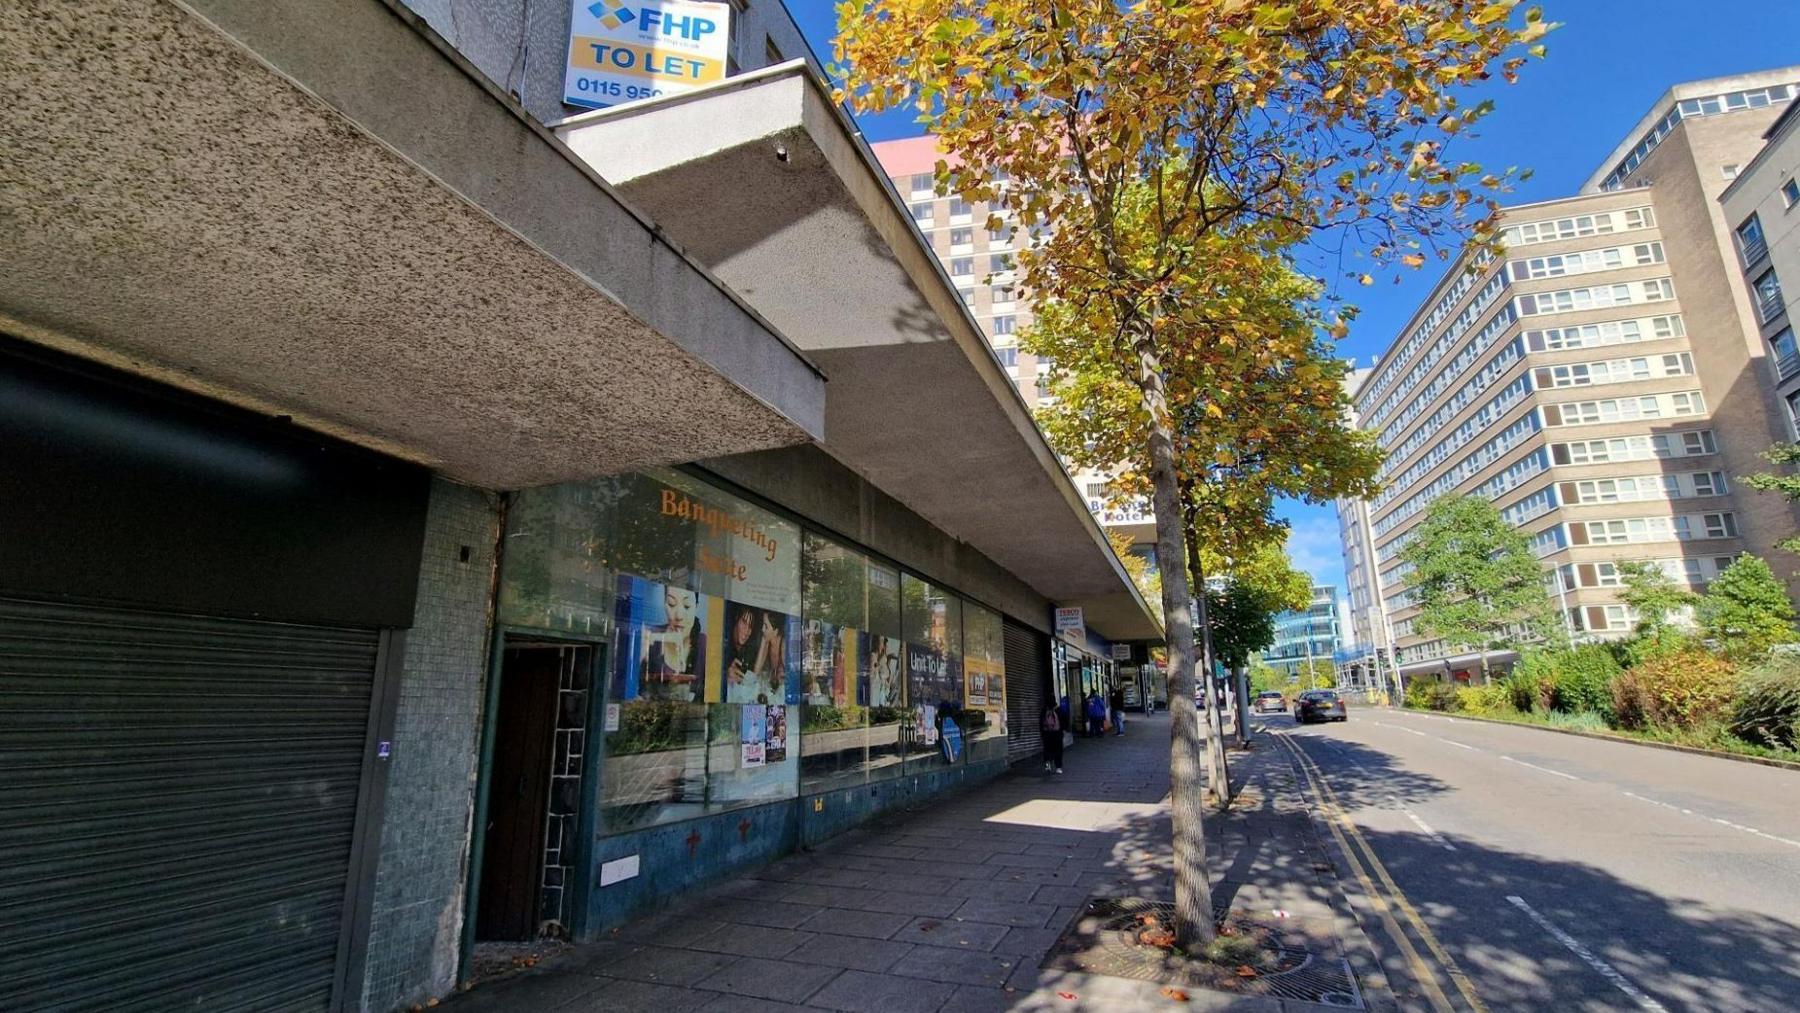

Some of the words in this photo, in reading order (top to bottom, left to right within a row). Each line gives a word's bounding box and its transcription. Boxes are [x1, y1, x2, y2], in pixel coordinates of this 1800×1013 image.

[639, 8, 716, 41] FHP
[590, 43, 635, 68] TO
[645, 53, 706, 79] LET
[577, 78, 620, 97] 0115
[910, 651, 926, 672] Unit
[926, 655, 936, 674] To
